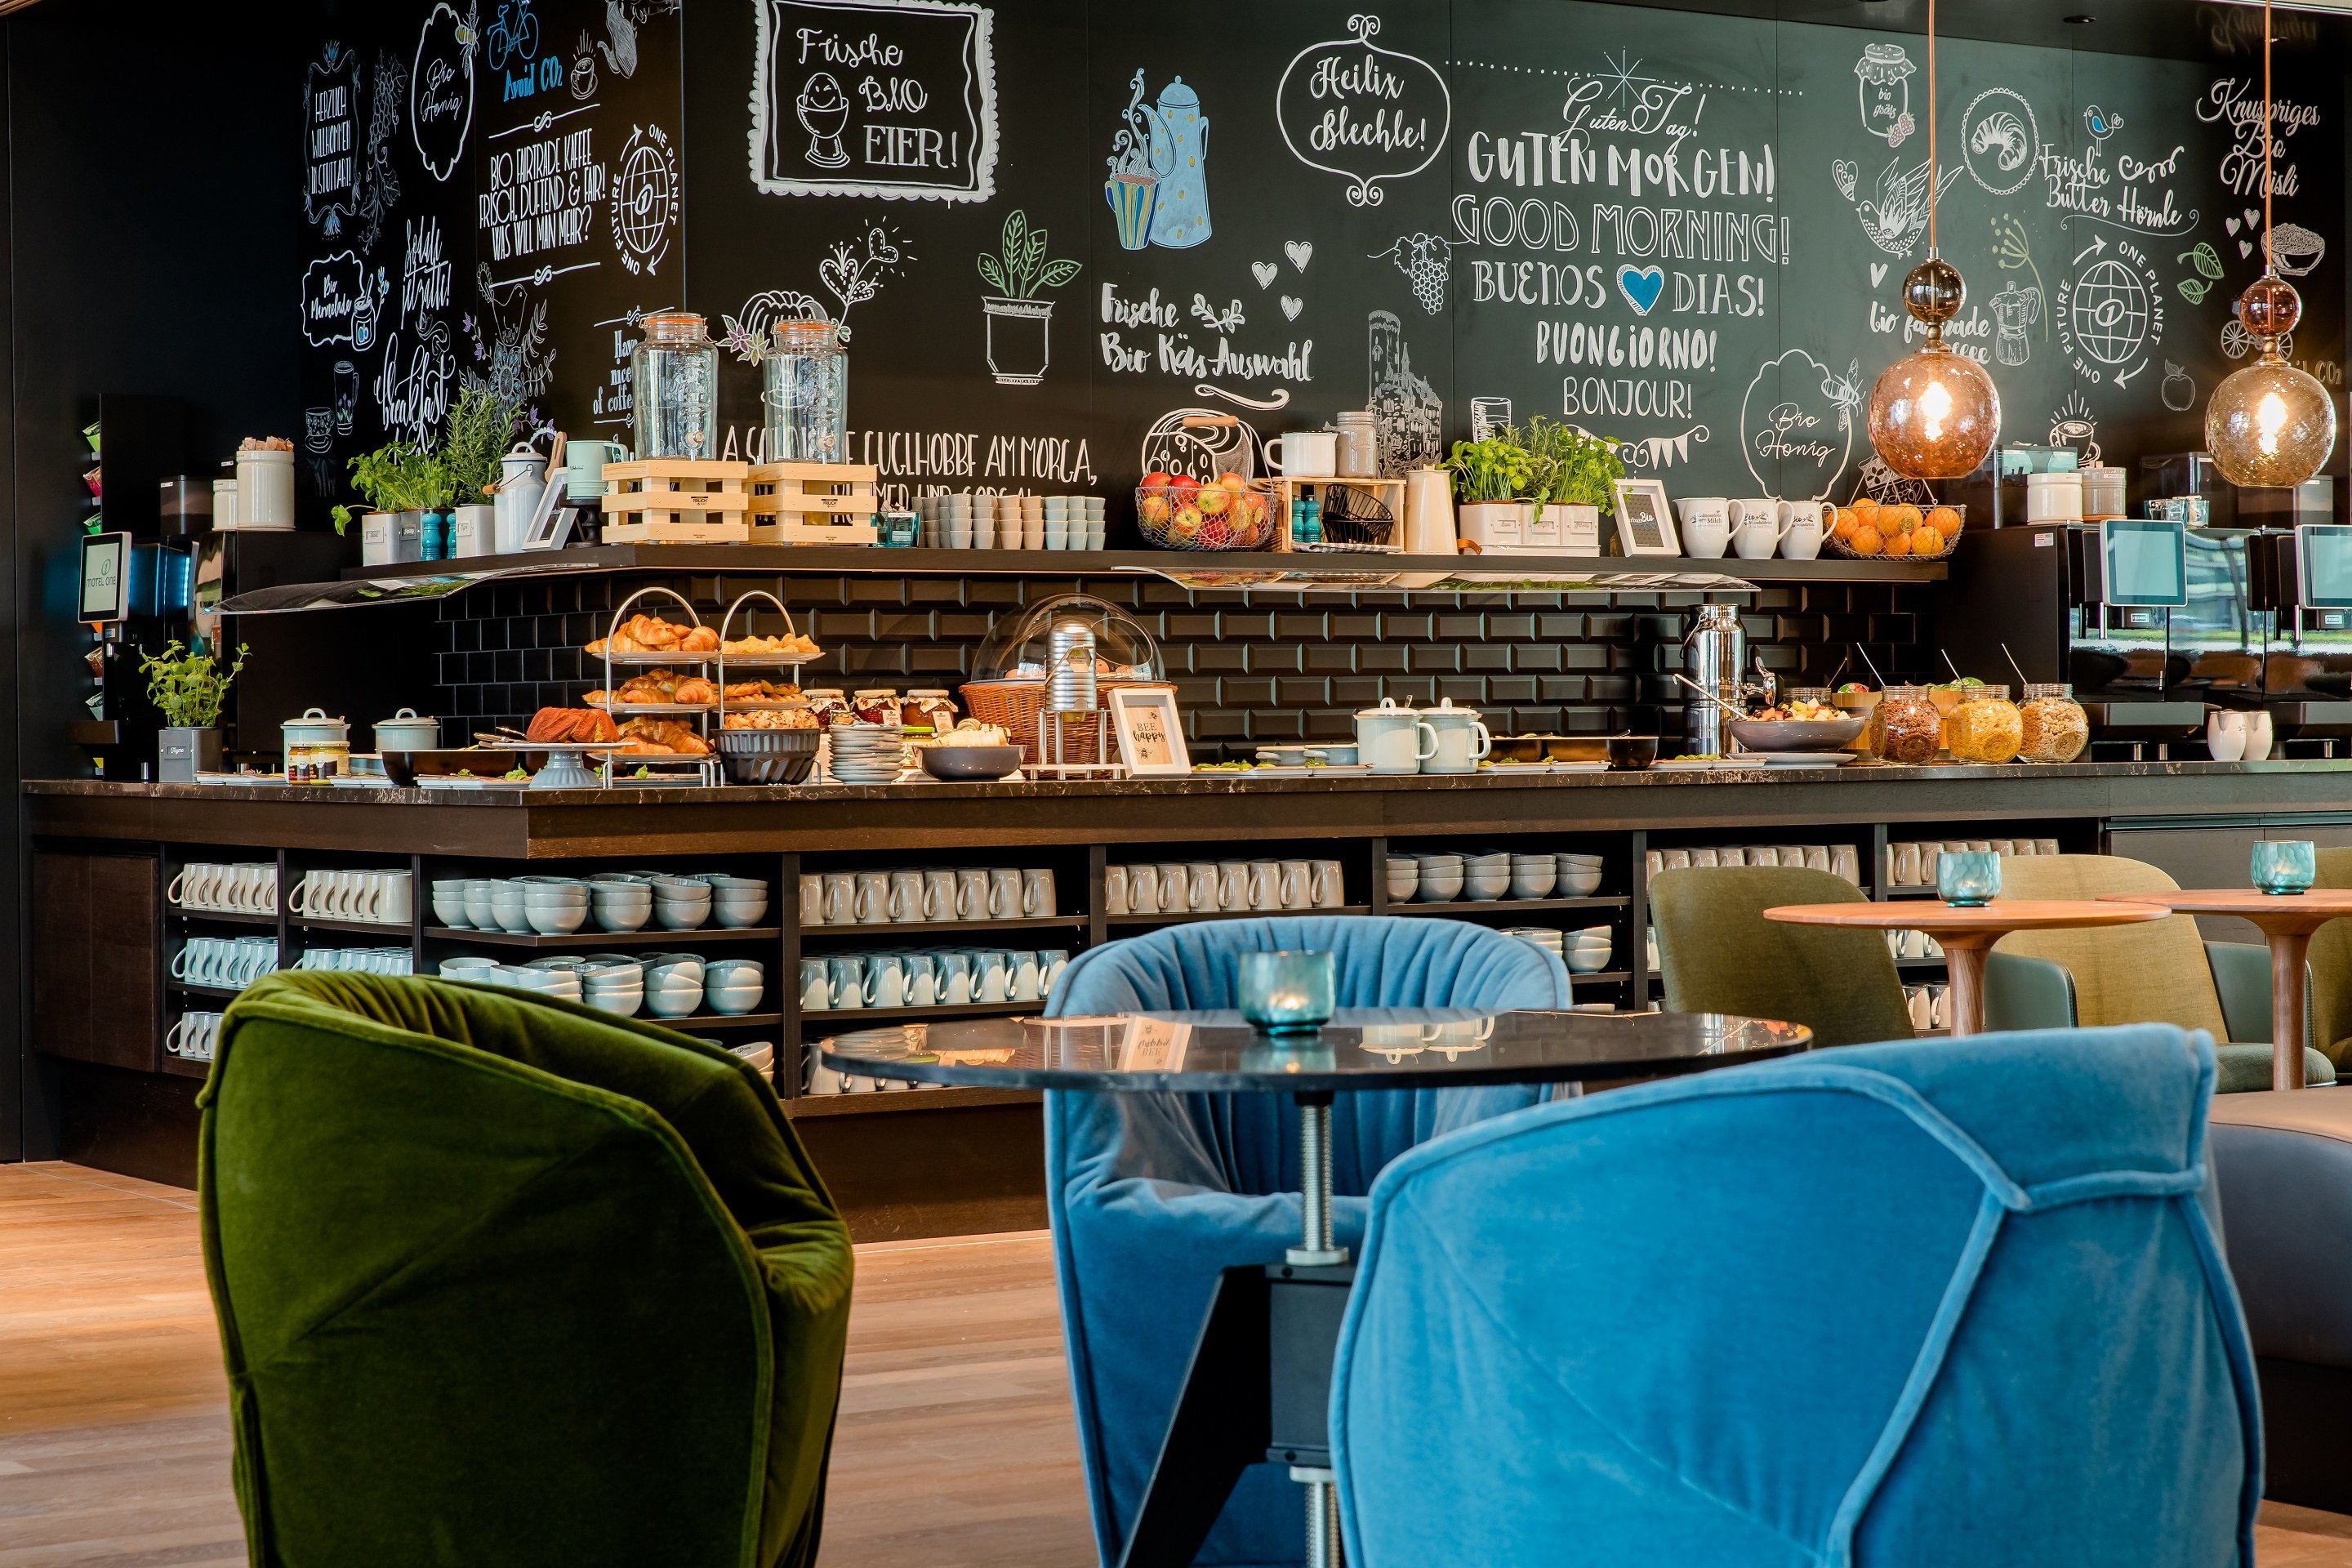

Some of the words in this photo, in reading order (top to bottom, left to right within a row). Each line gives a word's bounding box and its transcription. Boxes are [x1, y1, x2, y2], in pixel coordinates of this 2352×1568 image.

[796, 28, 903, 68] Frische
[426, 58, 455, 91] Bio
[504, 63, 536, 102] Avoid
[858, 76, 928, 113] BIO
[1310, 52, 1405, 101] Heilix
[1878, 87, 1891, 100] bio
[315, 86, 346, 122] HERZLICH
[421, 90, 462, 122] Honig
[1555, 77, 1630, 150] Guten
[1629, 83, 1707, 158] Tag!
[311, 120, 350, 158] WILLKOMMEN
[863, 125, 958, 169] EIER!
[1310, 109, 1427, 152] Blechle!
[2233, 119, 2286, 158] Bio
[491, 152, 513, 192] BIO
[516, 137, 560, 184] FAIRTRADE
[564, 128, 592, 171] KAFFEE
[648, 124, 667, 149] ONE
[666, 147, 679, 225] PLANET
[1608, 143, 1776, 203] MORGEN!
[2039, 143, 2110, 185] Frische
[479, 186, 518, 229] FRISCH,
[520, 175, 564, 219] DUFTEND
[568, 171, 580, 206] &
[584, 162, 606, 203] FAIR!
[611, 174, 624, 251] FUTURE
[2045, 174, 2111, 217] Butter
[2117, 185, 2182, 228] Hörnle
[492, 224, 510, 261] WAS
[514, 219, 533, 256] WILL
[537, 212, 556, 251] MAN
[559, 204, 592, 247] MEHR?
[1451, 194, 1579, 253] GOOD
[1592, 203, 1790, 265] MORNING!
[621, 248, 640, 275] ONE
[311, 292, 352, 320] Marmelade
[323, 274, 338, 298] Bio
[1101, 283, 1179, 328] Frische
[1472, 261, 1606, 310] BUENOS
[1672, 270, 1765, 317] DIAS!
[2118, 241, 2147, 268] ONE
[2145, 269, 2163, 345] PLANET
[1869, 301, 1900, 333] bio
[1904, 305, 1992, 344] farade
[2056, 278, 2074, 354] FUTURE
[1100, 331, 1152, 373] Bio
[2073, 356, 2100, 383] ONE
[374, 332, 456, 455] breakfast
[611, 367, 632, 385] nice
[593, 385, 604, 415] of
[608, 383, 634, 412] coffe
[1563, 376, 1692, 419] BONJOUR!
[1769, 403, 1821, 431] Bio
[984, 434, 1016, 478] AM
[1755, 428, 1837, 468] Honig
[86, 577, 105, 588] MOTEL
[105, 576, 116, 586] ONE
[1133, 730, 1165, 743] happy
[1137, 722, 1157, 732] BEE
